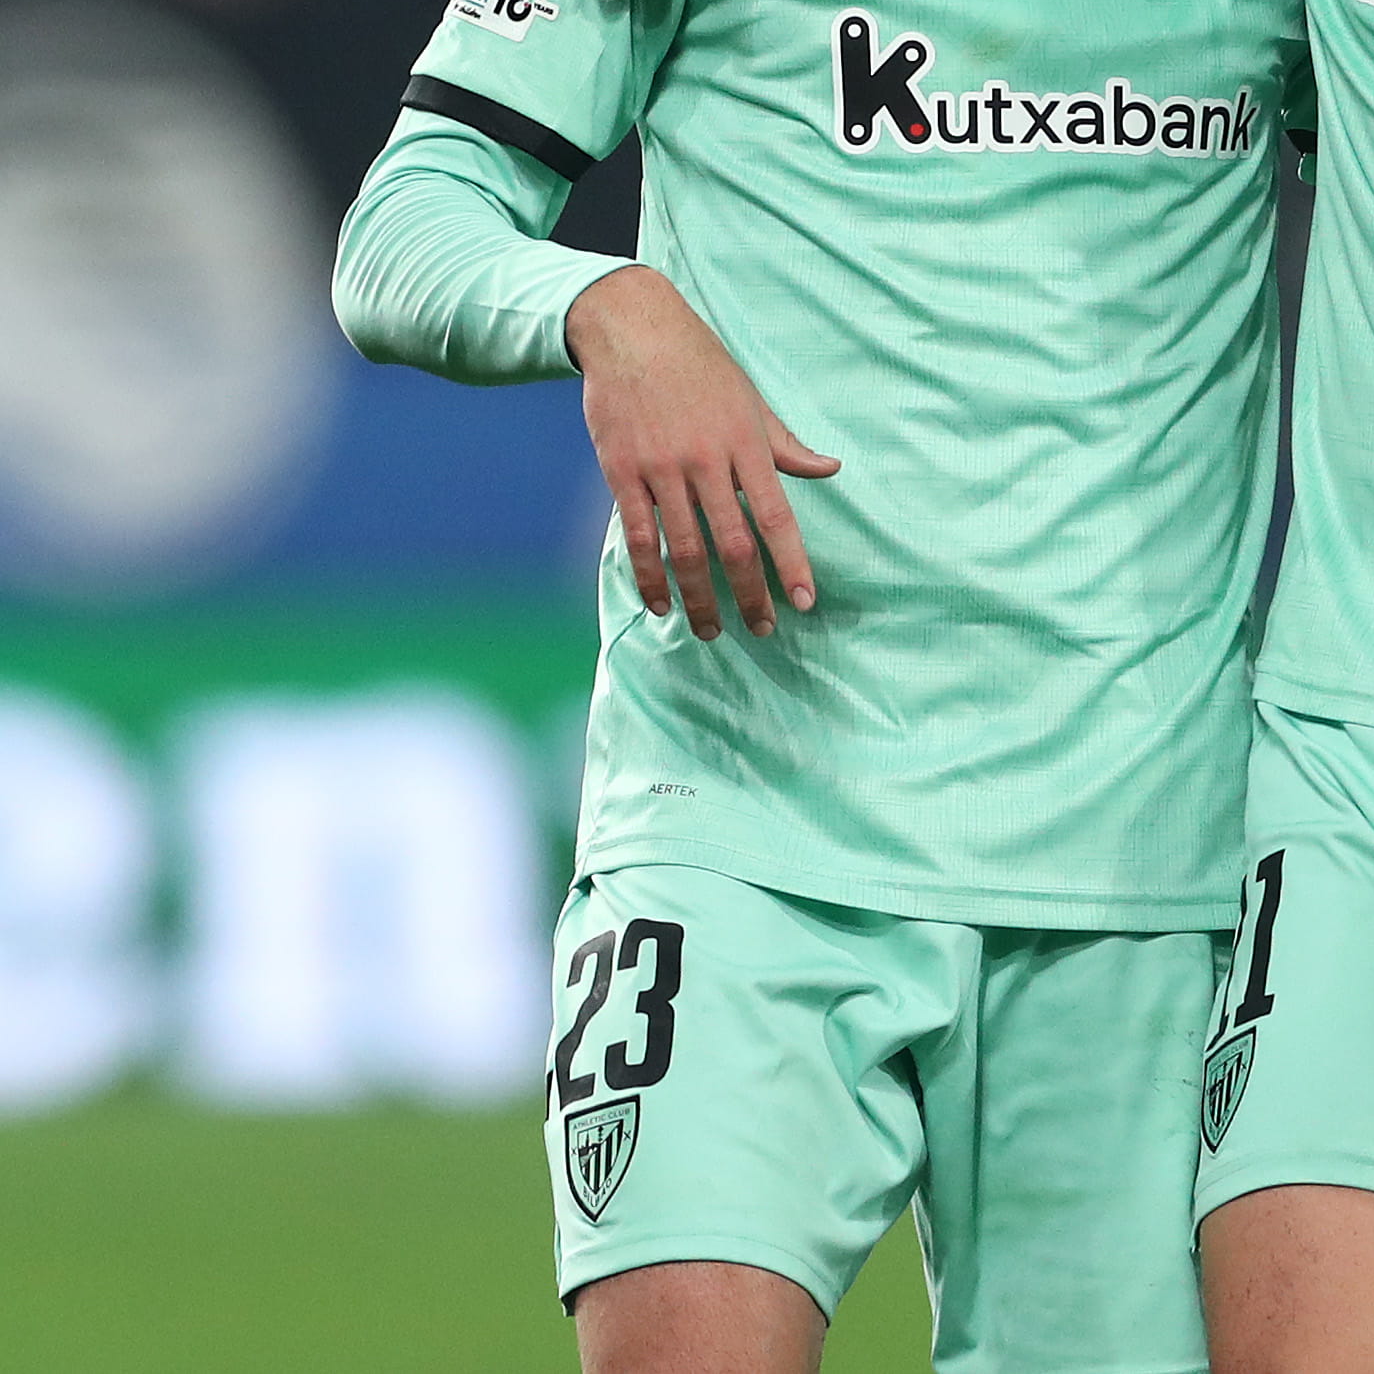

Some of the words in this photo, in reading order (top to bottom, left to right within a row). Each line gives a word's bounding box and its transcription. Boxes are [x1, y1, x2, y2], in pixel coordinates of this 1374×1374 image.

[840, 16, 1257, 151] Kutxabank
[648, 783, 699, 798] AERTEK
[555, 918, 684, 1112] 23
